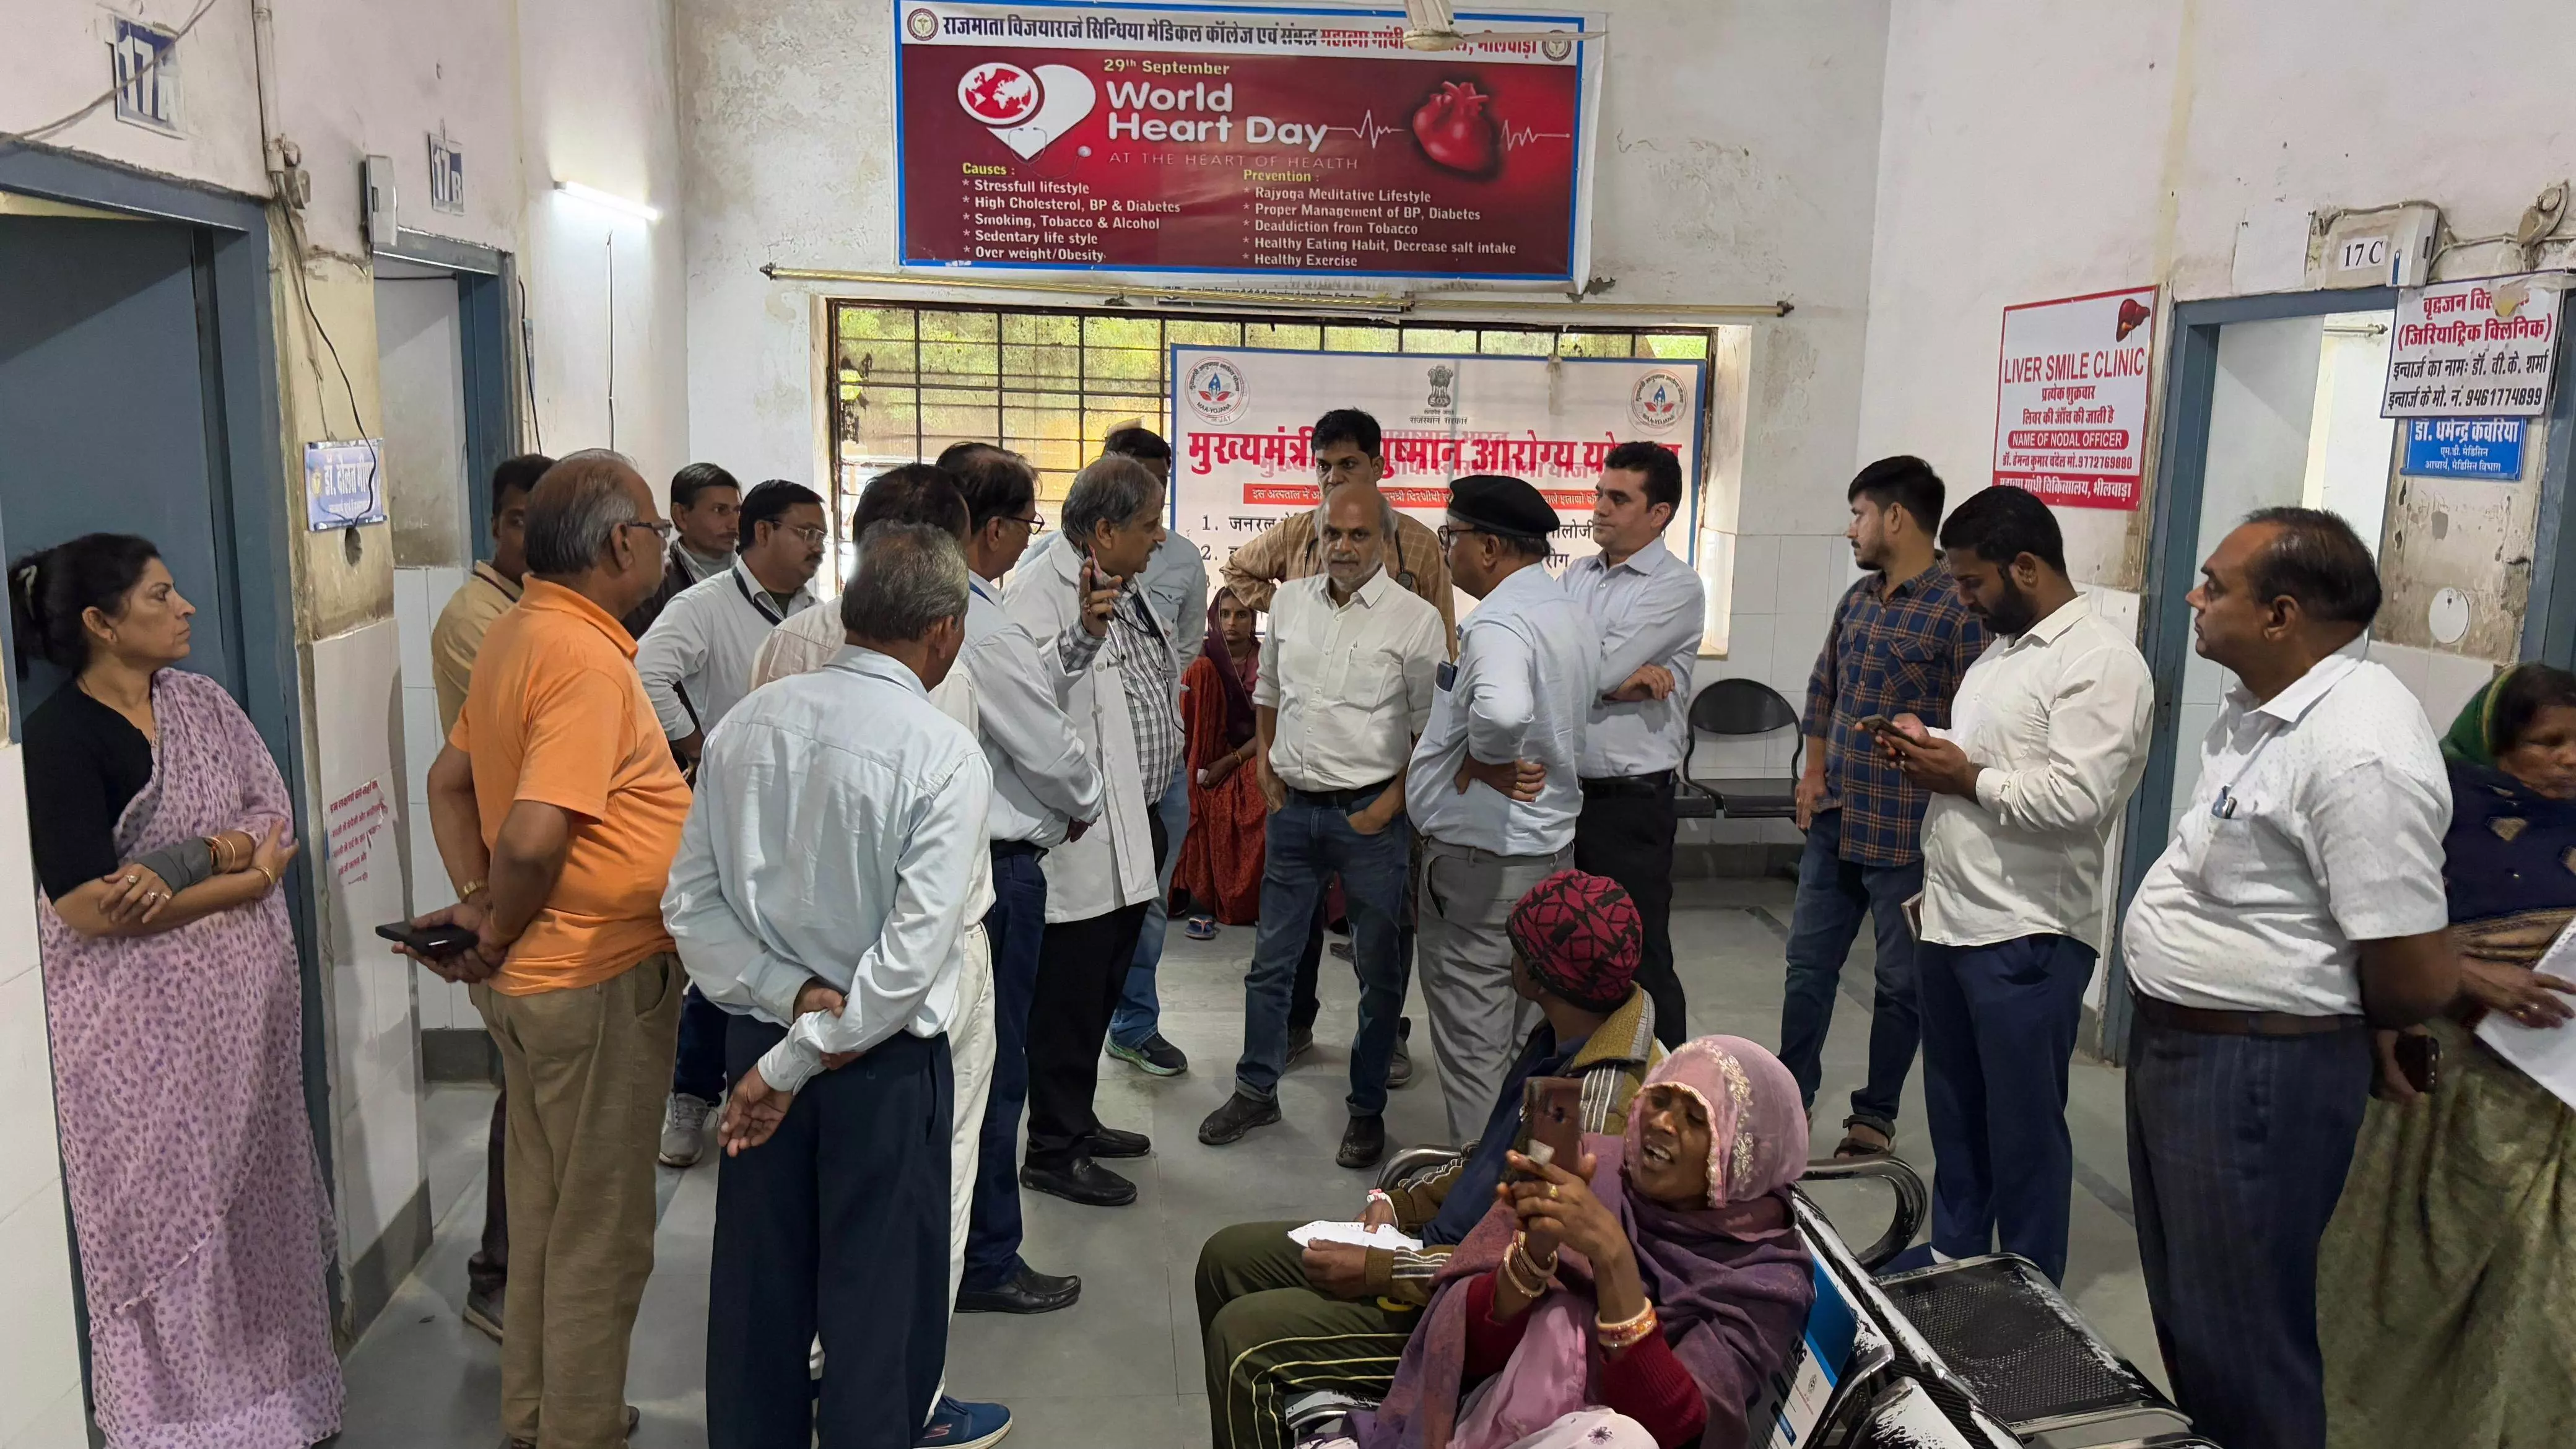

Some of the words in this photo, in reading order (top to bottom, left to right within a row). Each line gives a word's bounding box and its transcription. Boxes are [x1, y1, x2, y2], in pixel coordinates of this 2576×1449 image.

[943, 16, 1005, 36] राजमाता
[1007, 14, 1083, 38] विजयाराजे
[1086, 16, 1144, 41] सिन्धिया
[1147, 19, 1203, 41] मेडिकल
[1206, 20, 1254, 44] कॉलेज
[1256, 22, 1279, 45] एवं
[1104, 59, 1136, 72] 29th
[1142, 61, 1230, 76] September
[1106, 81, 1233, 112] World
[1108, 112, 1233, 142] Heart
[1246, 116, 1328, 153] Day
[962, 162, 1007, 175] Causes
[1109, 152, 1130, 163] AT
[1142, 153, 1174, 165] THE
[1186, 154, 1243, 167] HEART
[1255, 155, 1278, 167] OF
[1289, 157, 1357, 169] HEALTH
[1243, 169, 1311, 182] Prevention
[975, 180, 1035, 193] Stressfull
[1040, 181, 1089, 196] lifestyle
[1256, 186, 1304, 201] Rajyoga
[1309, 188, 1375, 201] Meditative
[1379, 189, 1431, 204] Lifestyle
[975, 197, 1005, 210] High
[1009, 197, 1085, 212] Cholesterol,
[1090, 199, 1107, 211] BP
[1112, 200, 1123, 211] &
[1127, 200, 1180, 212] Diabetes
[1256, 202, 1297, 217] Proper
[1302, 204, 1382, 218] Management
[1387, 206, 1399, 218] of
[1404, 206, 1424, 220] BP,
[1429, 207, 1481, 220] Diabetes
[975, 214, 1036, 228] Smoking,
[1040, 215, 1093, 228] Tobacco
[1097, 216, 1108, 228] &
[1113, 217, 1159, 229] Alcohol
[1255, 219, 1329, 233] Deaddiction
[1333, 221, 1363, 233] from
[1367, 222, 1418, 235] Tobacco
[975, 230, 1040, 245] Sedentary
[1044, 231, 1064, 244] life
[1069, 233, 1098, 246] style
[1255, 237, 1302, 251] Healthy
[1307, 238, 1347, 252] Eating
[1352, 239, 1389, 253] Habit,
[1394, 240, 1447, 253] Decrease
[1451, 242, 1474, 254] salt
[1477, 242, 1516, 255] intake
[975, 246, 1004, 259] Over
[1255, 253, 1302, 267] Healthy
[1307, 255, 1357, 267] Exercise
[2345, 243, 2364, 267] 17
[2369, 241, 2383, 264] C
[2004, 356, 2042, 384] LIVER
[2046, 352, 2089, 381] SMILE
[2094, 347, 2144, 379] CLINIC
[2428, 360, 2442, 377] का
[2472, 352, 2486, 375] डॉ.
[2526, 349, 2549, 374] शर्मा
[2042, 383, 2065, 402] प्रत्येक
[2420, 385, 2432, 406] के
[2432, 385, 2446, 407] मो.
[2451, 385, 2461, 406] नं.
[2466, 388, 2542, 406] 9461774899
[2022, 407, 2042, 425] लिवर
[2043, 407, 2053, 424] की
[2073, 406, 2084, 424] की
[2086, 406, 2107, 424] जाती
[2107, 404, 2115, 424] है
[2012, 433, 2035, 446] NAME
[2037, 433, 2049, 446] OF
[2051, 432, 2080, 446] NODAL
[2082, 432, 2122, 446] OFFICER
[1188, 426, 1316, 474] मुख्यमंत्री
[1471, 430, 1578, 473] आरोग्य
[1202, 515, 1218, 531] 1.
[1201, 544, 1218, 560] 2.
